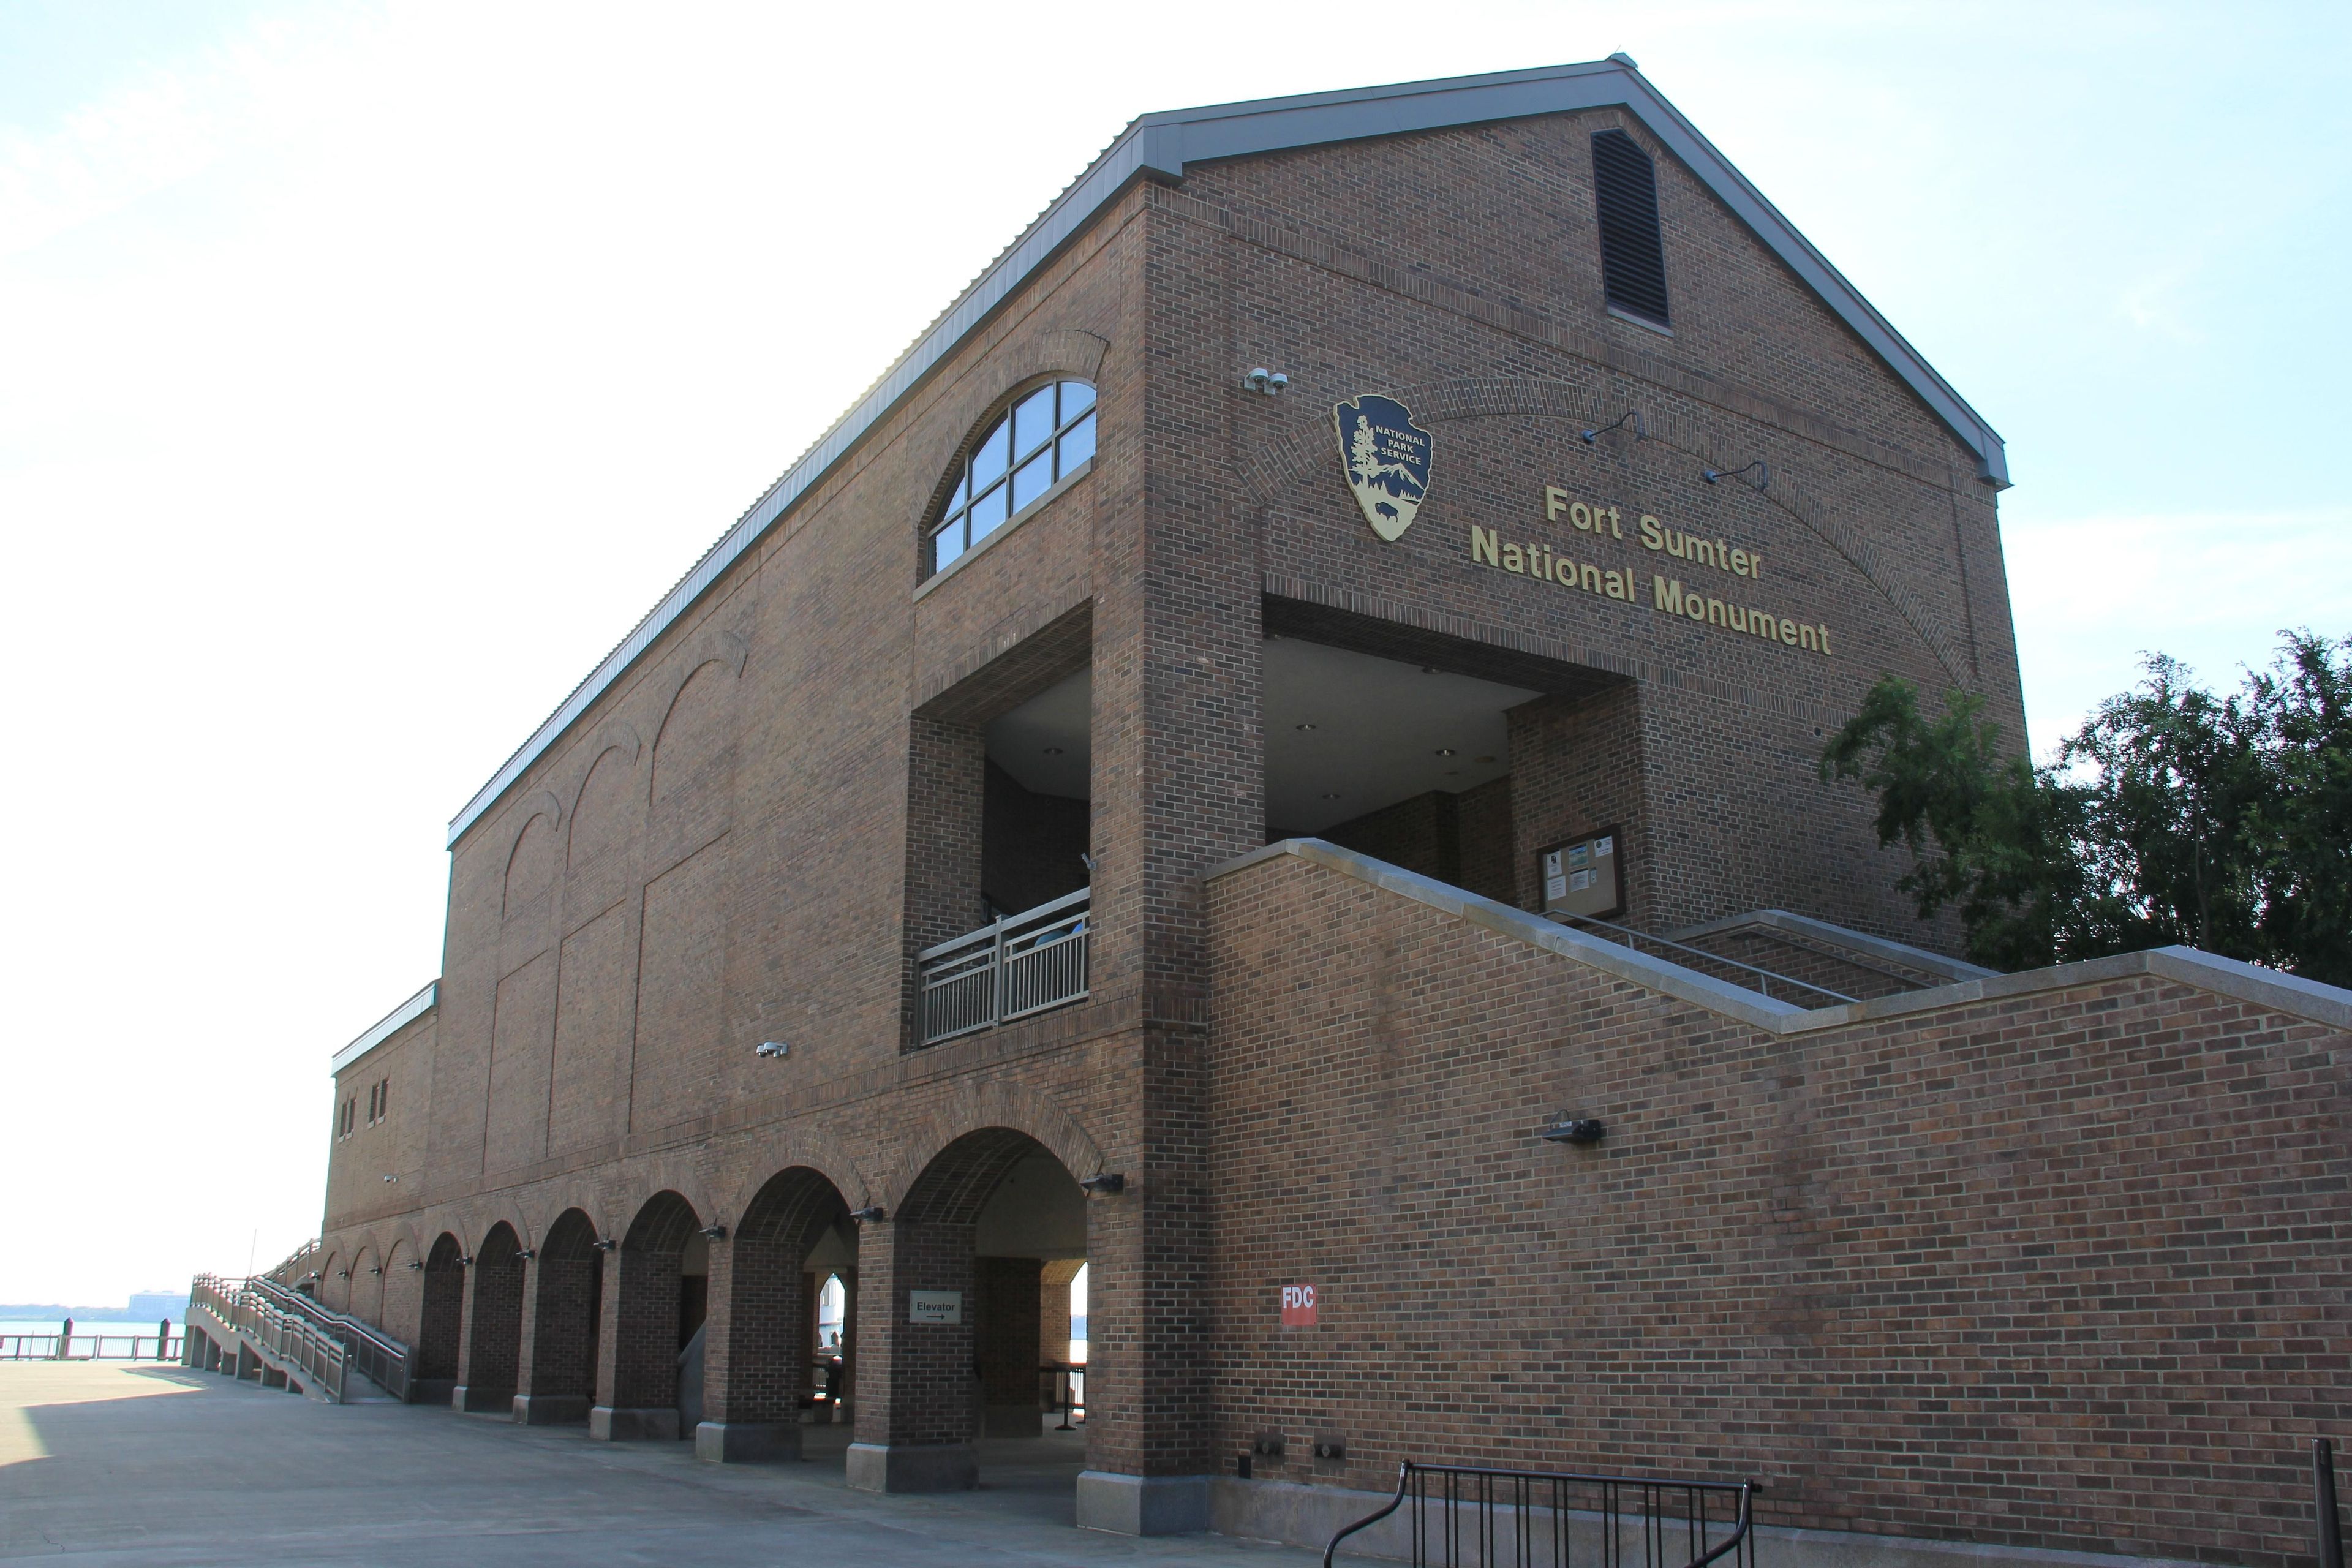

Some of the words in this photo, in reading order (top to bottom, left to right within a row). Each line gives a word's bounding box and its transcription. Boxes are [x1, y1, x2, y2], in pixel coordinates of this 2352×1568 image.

[1376, 425, 1425, 446] NATIONAL
[1387, 439, 1414, 453] PARK
[1381, 447, 1421, 465] SERVICE
[1545, 485, 1623, 540] Fort
[1640, 514, 1761, 579] Sumter
[1471, 524, 1635, 601] National
[1653, 575, 1832, 656] Monument
[917, 1302, 955, 1311] Elevator
[1283, 1286, 1314, 1309] FDC
